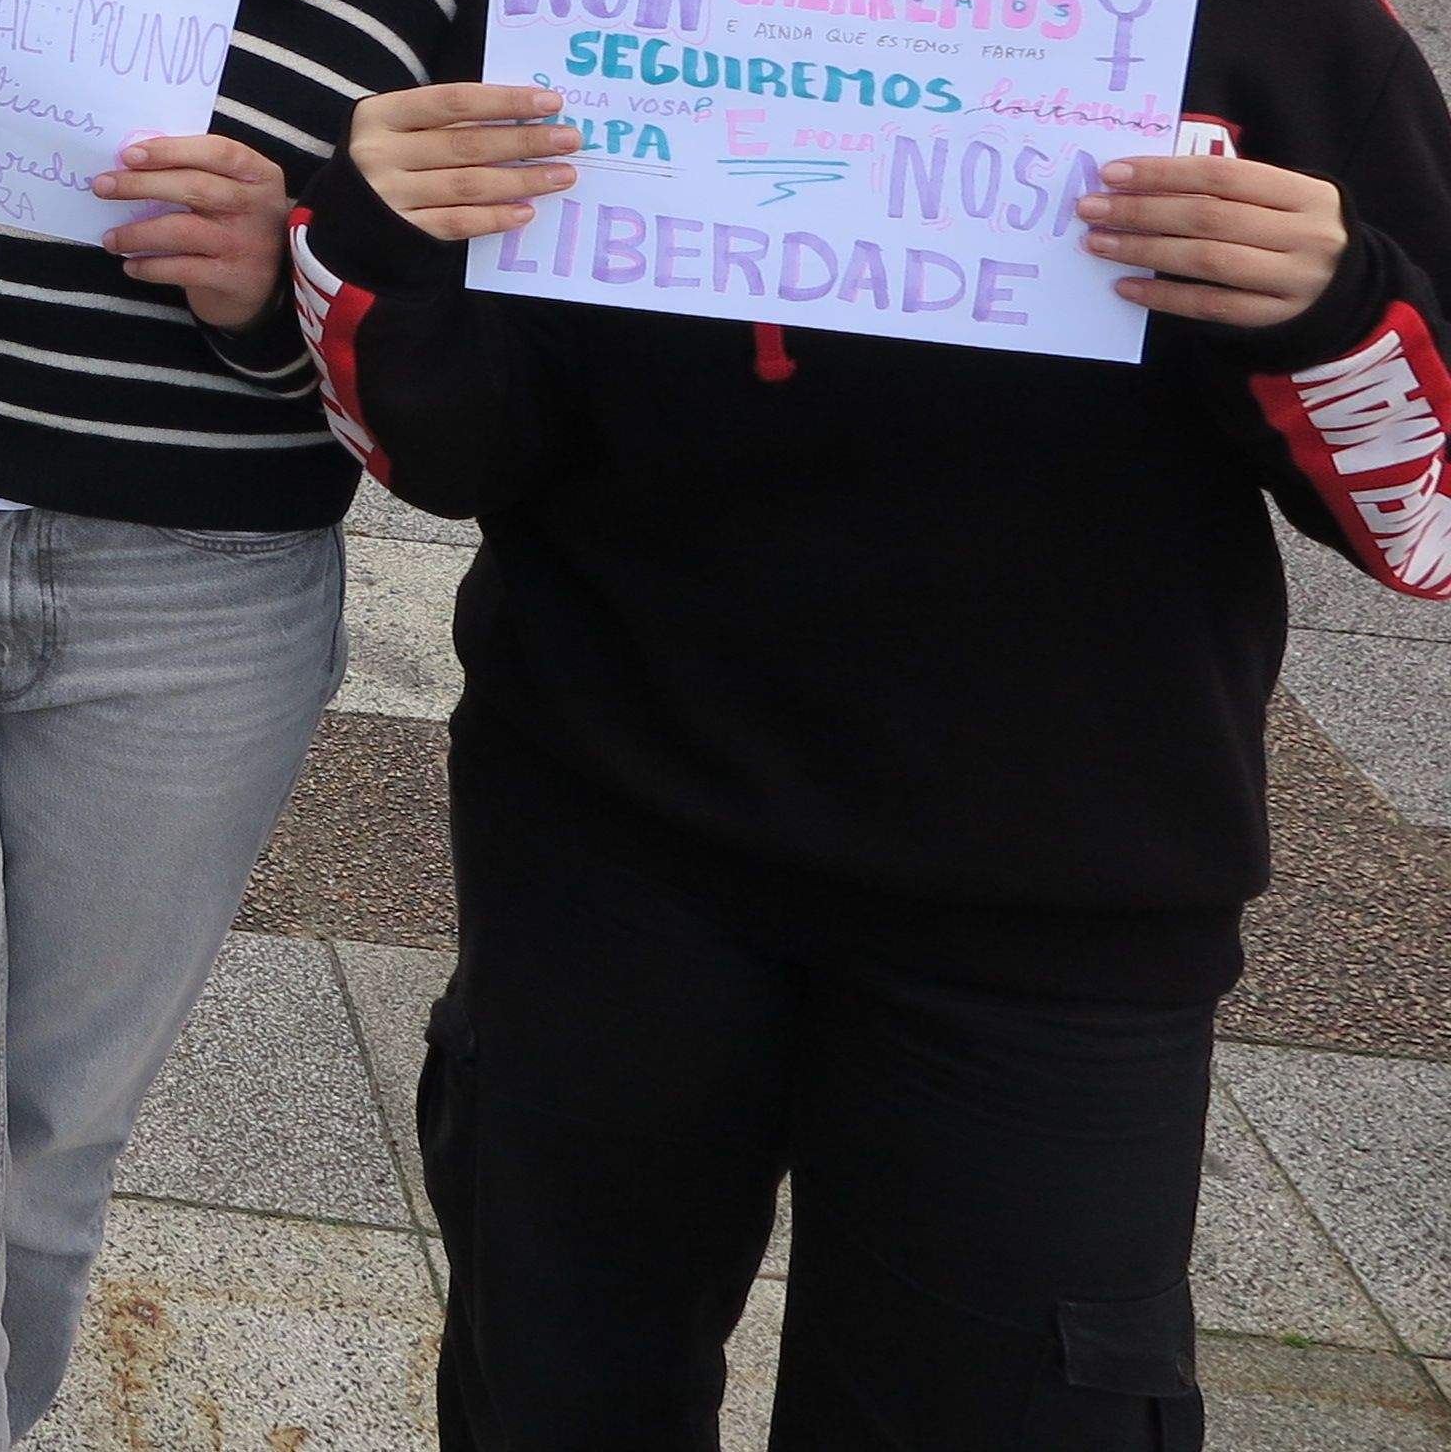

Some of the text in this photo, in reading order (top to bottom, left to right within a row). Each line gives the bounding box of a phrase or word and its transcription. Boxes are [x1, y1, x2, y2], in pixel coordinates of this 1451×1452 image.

[726, 19, 1047, 61] E AINDA QUE ESTEMOS FARTAS
[565, 30, 964, 113] SEGUIREMOS
[628, 95, 693, 117] VOSA
[516, 114, 672, 162] LPA
[725, 108, 770, 157] E
[793, 128, 875, 153] POLA
[499, 198, 1040, 327] LIBERDADE
